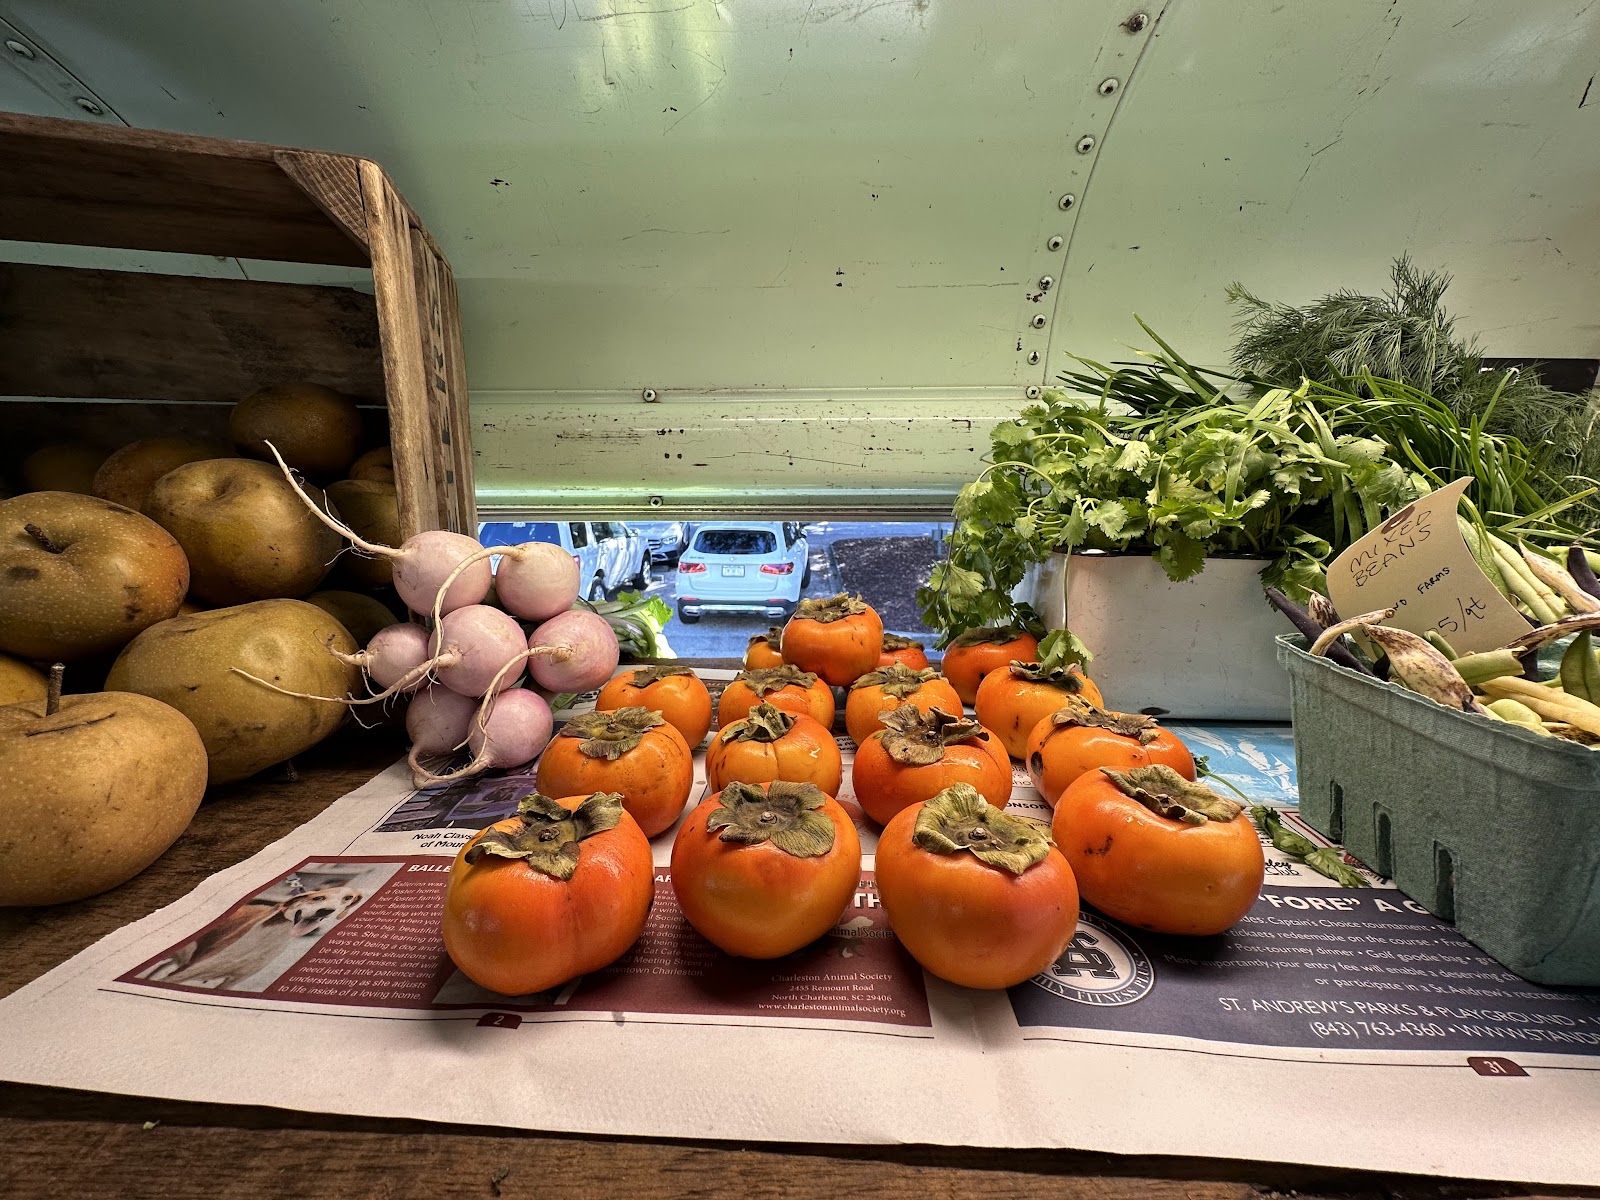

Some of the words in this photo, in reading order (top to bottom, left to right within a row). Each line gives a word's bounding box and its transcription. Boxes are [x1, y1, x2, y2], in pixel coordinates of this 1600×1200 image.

[1350, 510, 1432, 573] MIXED
[1352, 524, 1432, 588] BEANS
[1417, 566, 1451, 595] FARMS
[412, 832, 441, 840] Noah
[1373, 898, 1404, 914] A
[655, 914, 687, 923] Society
[1319, 919, 1362, 929] Choice
[1362, 922, 1431, 932] tournament
[658, 923, 693, 932] animals
[361, 930, 380, 938] She
[389, 933, 426, 944] learning
[653, 939, 679, 948] being
[1277, 931, 1346, 942] redeemable
[1365, 934, 1388, 945] the
[364, 940, 391, 950] being
[398, 943, 417, 951] dog
[643, 947, 660, 955] Cat
[318, 946, 332, 954] be
[332, 947, 350, 956] shy
[382, 951, 428, 960] situations
[1234, 943, 1314, 956] Post-tourney
[1316, 946, 1355, 957] dinner
[1365, 949, 1397, 960] Golf
[1396, 953, 1441, 963] goodie
[1440, 953, 1469, 965] bag
[308, 957, 345, 965] around
[344, 958, 368, 966] loud
[633, 956, 672, 966] Meeting
[299, 966, 326, 974] need
[321, 967, 344, 976] just
[351, 968, 374, 976] little
[373, 969, 416, 978] patience
[771, 974, 820, 982] Charleston
[823, 973, 858, 981] Animal
[859, 972, 893, 982] Society
[1304, 962, 1338, 973] entry
[1338, 962, 1360, 972] fee
[1361, 964, 1386, 974] will
[1385, 965, 1427, 977] enable
[1438, 968, 1505, 984] deserving
[288, 975, 359, 988] understanding
[372, 979, 391, 987] she
[391, 980, 428, 989] adjusts
[811, 984, 850, 992] Remount
[852, 984, 874, 992] Road
[1077, 987, 1140, 1004] FITNESS
[1133, 960, 1150, 989] PLUS
[1314, 977, 1330, 986] or
[1332, 978, 1405, 992] participate
[1405, 982, 1420, 992] in
[289, 985, 307, 994] life
[307, 987, 338, 996] inside
[338, 988, 353, 996] of
[359, 989, 391, 1000] loving
[866, 994, 893, 1002] 29406
[1219, 997, 1248, 1012] ST.
[1252, 998, 1355, 1015] ANDREW'S
[1353, 1001, 1419, 1017] PARKS
[1419, 1005, 1437, 1018] &
[1434, 1005, 1576, 1027] PLAYGROUND
[493, 1015, 505, 1025] 2
[1309, 1021, 1360, 1040] (843)
[1356, 1021, 1446, 1038] 763-4360
[1483, 1060, 1508, 1075] 31
